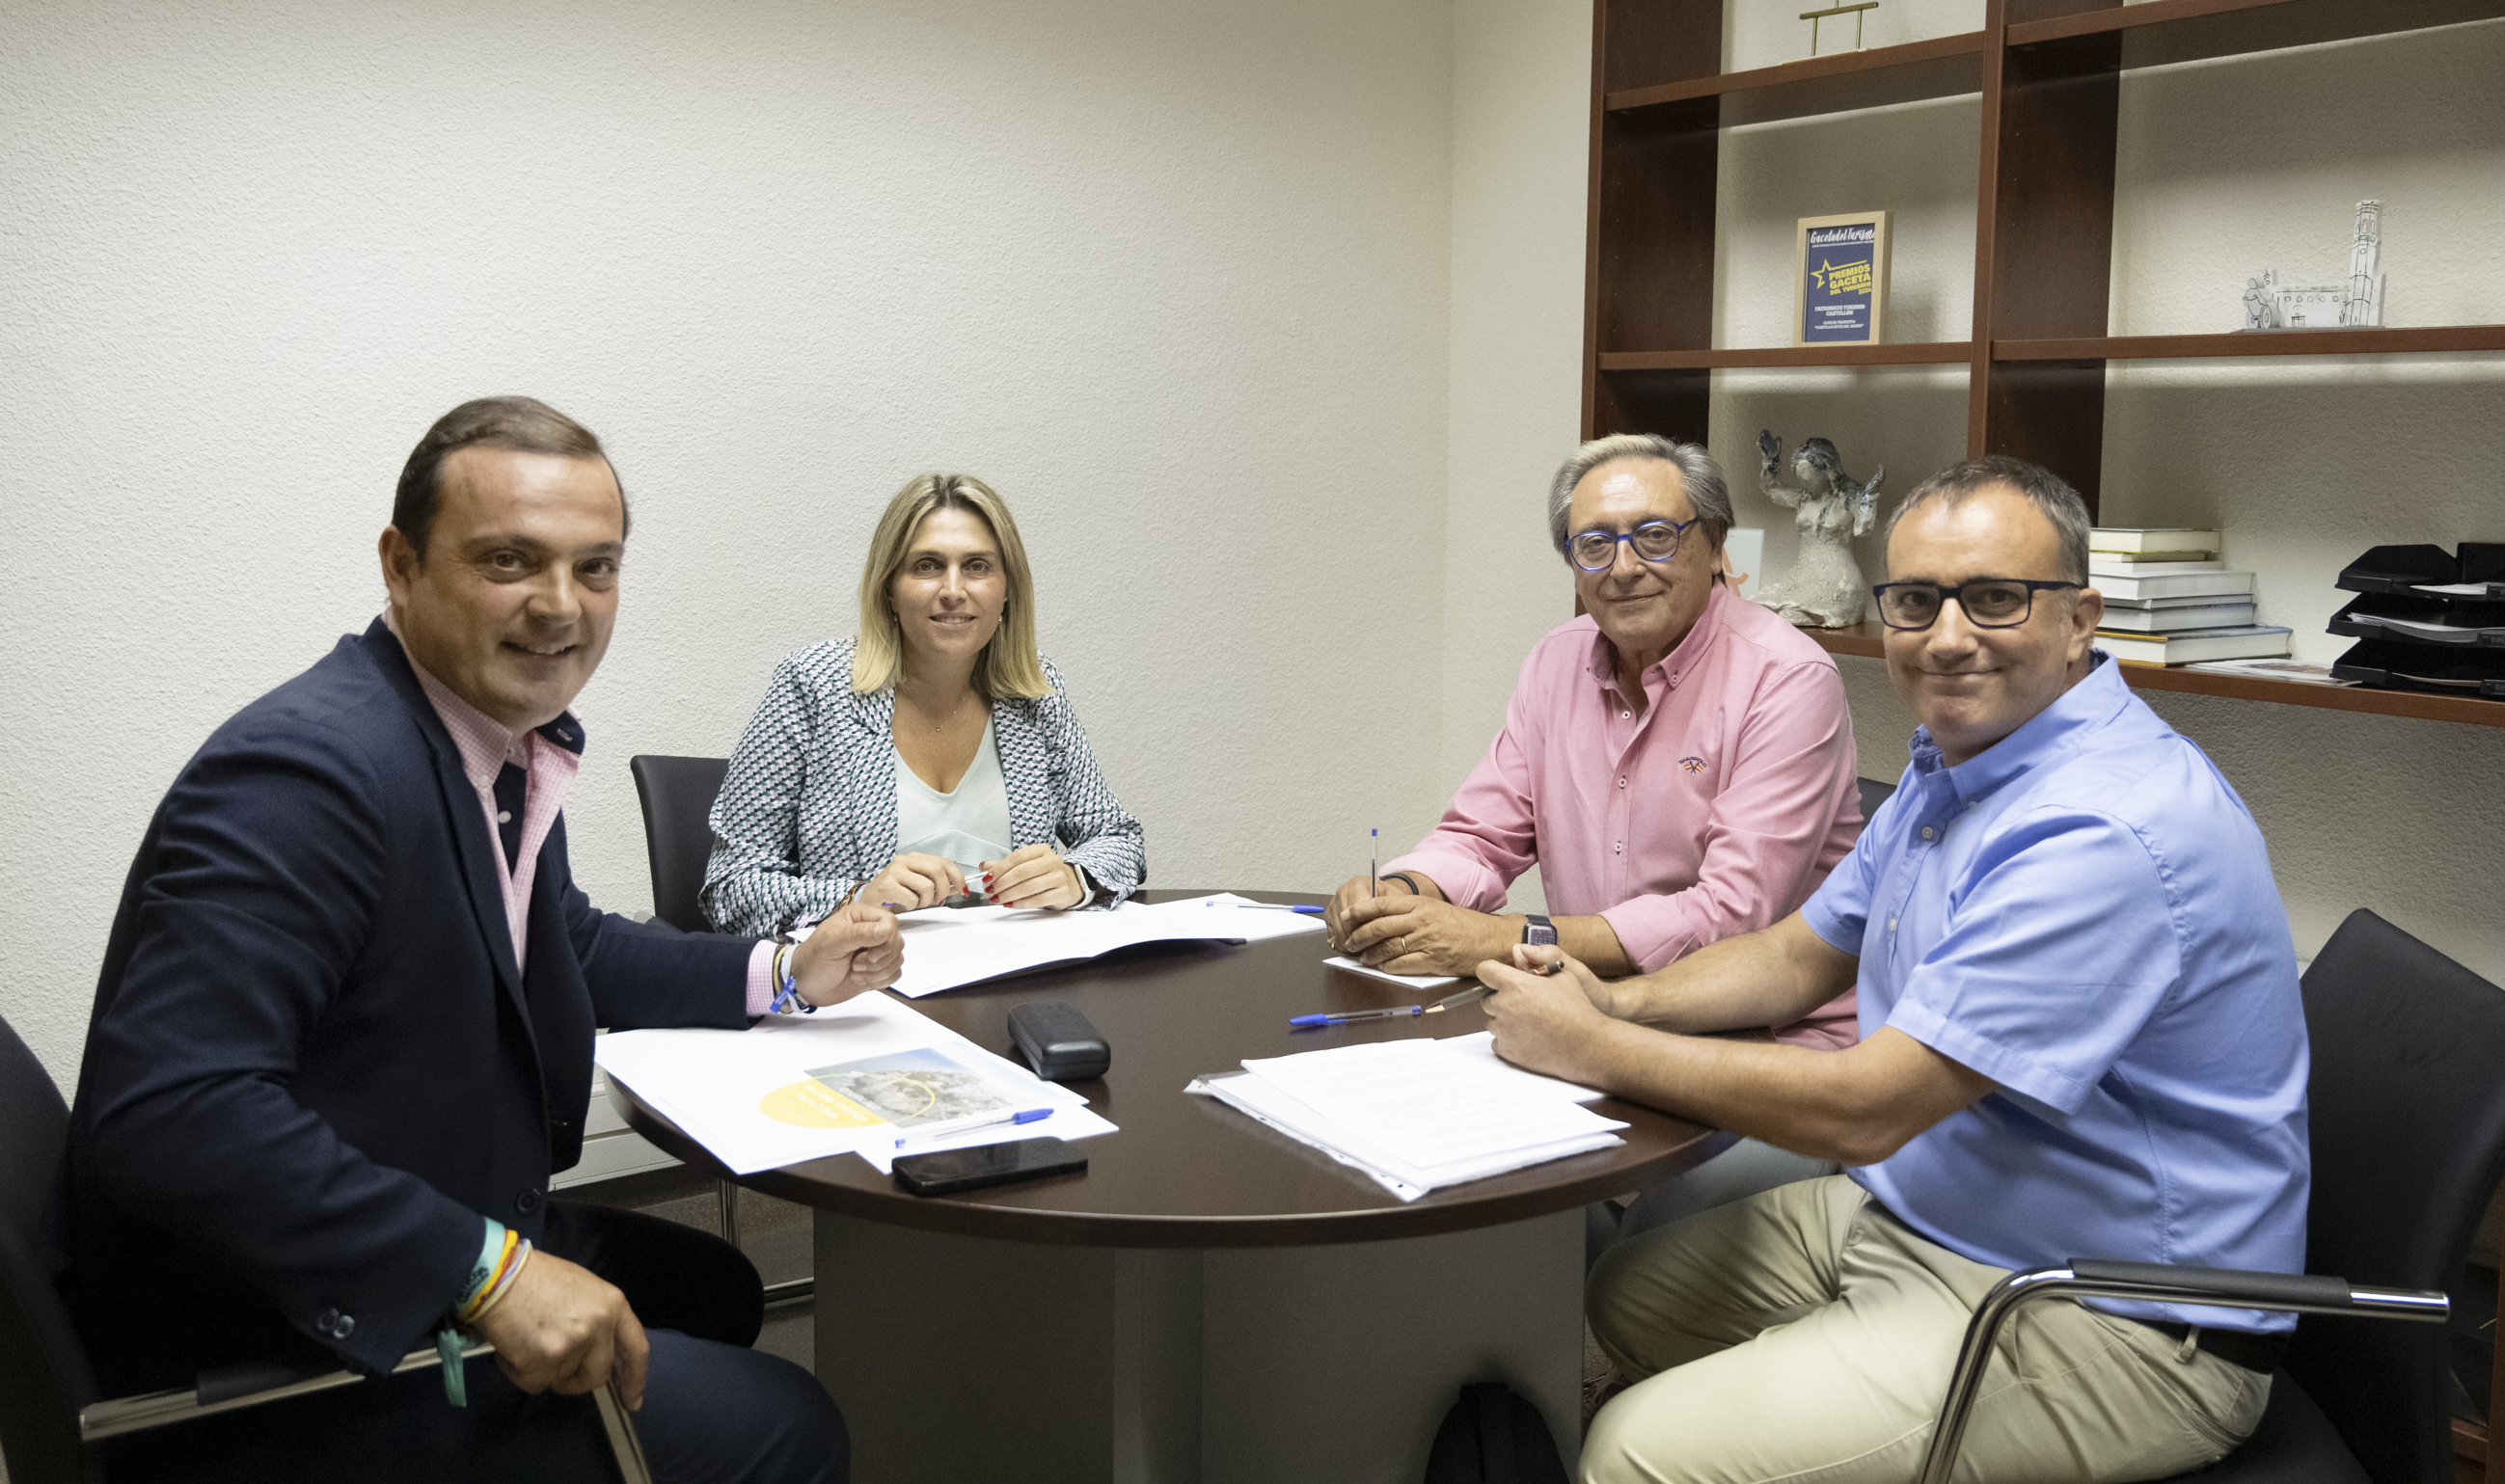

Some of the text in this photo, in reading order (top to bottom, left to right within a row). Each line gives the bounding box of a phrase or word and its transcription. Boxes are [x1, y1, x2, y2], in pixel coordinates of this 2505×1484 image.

[1829, 263, 1870, 281] PREMIOS
[1830, 273, 1871, 289] GACETA
[1842, 282, 1871, 292] TURISMO
